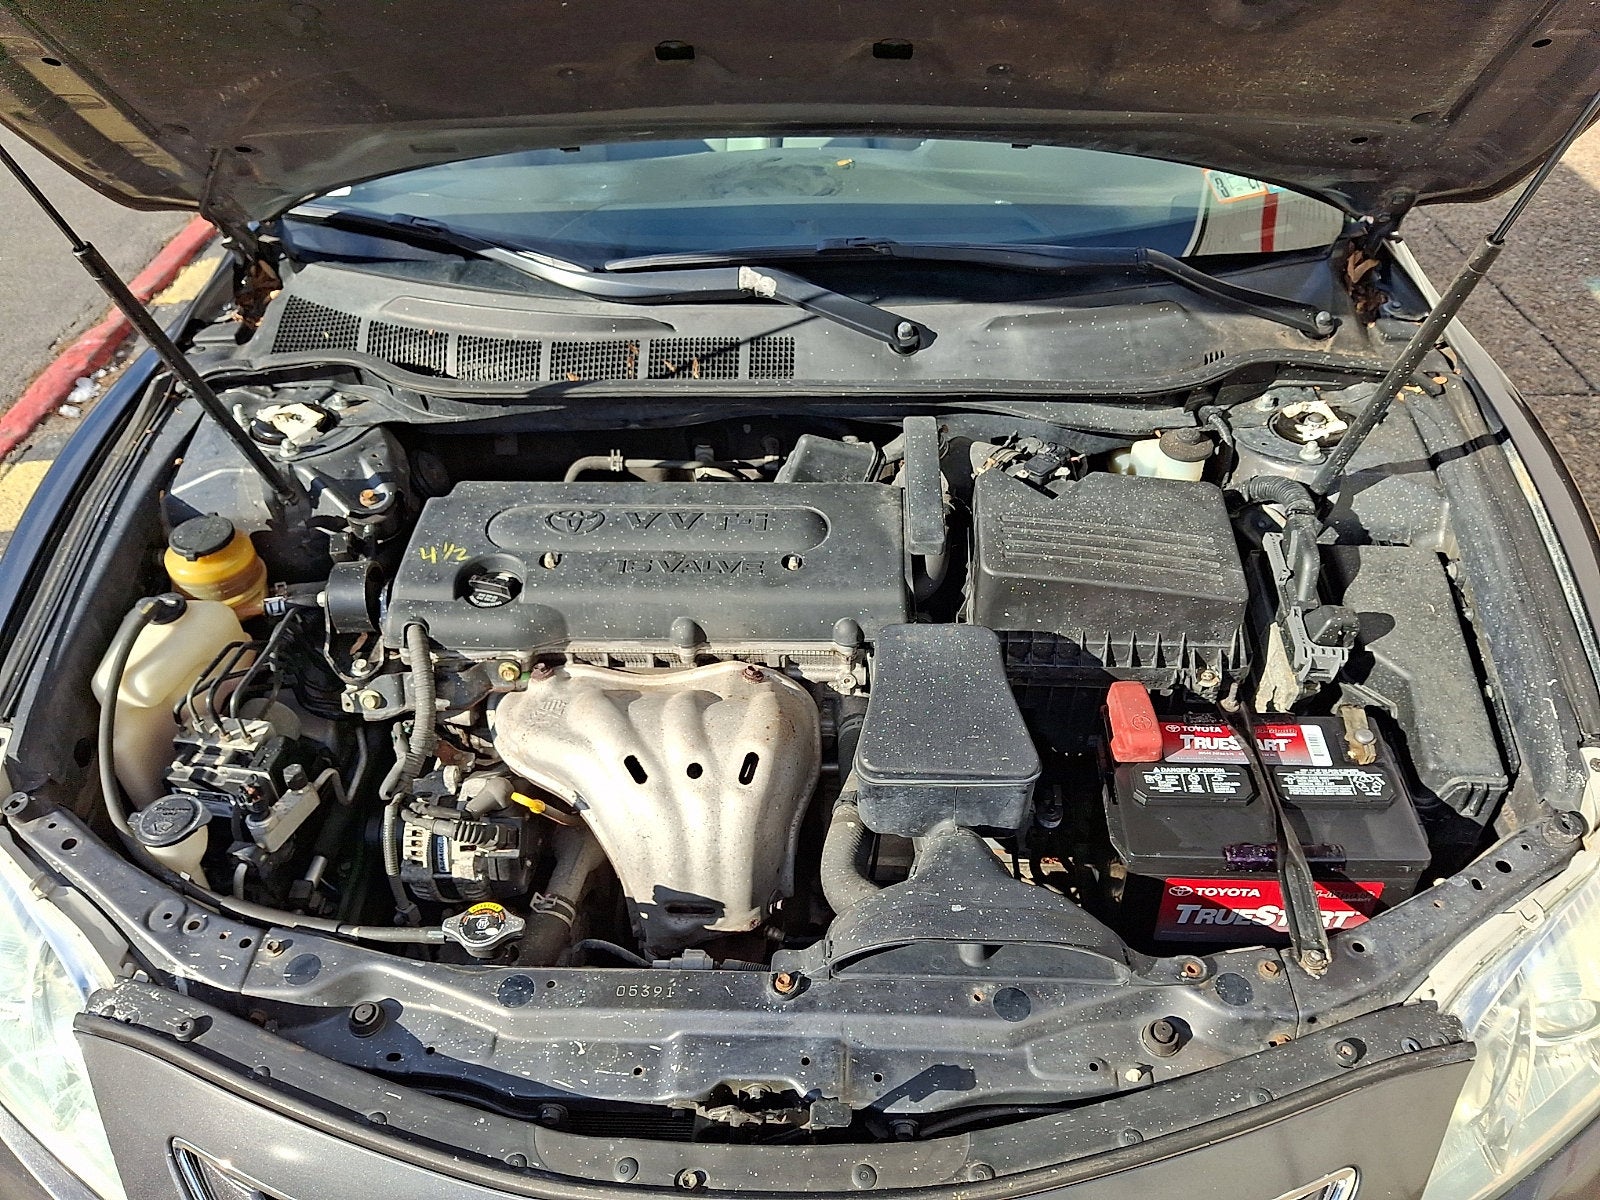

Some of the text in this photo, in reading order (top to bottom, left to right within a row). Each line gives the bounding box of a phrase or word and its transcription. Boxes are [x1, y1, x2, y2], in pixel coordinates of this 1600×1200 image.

[624, 511, 769, 532] VVT-i
[419, 546, 437, 564] 4
[1180, 725, 1223, 733] TOYOTA
[1195, 887, 1261, 898] TOYOTA
[616, 984, 673, 998] 05391
